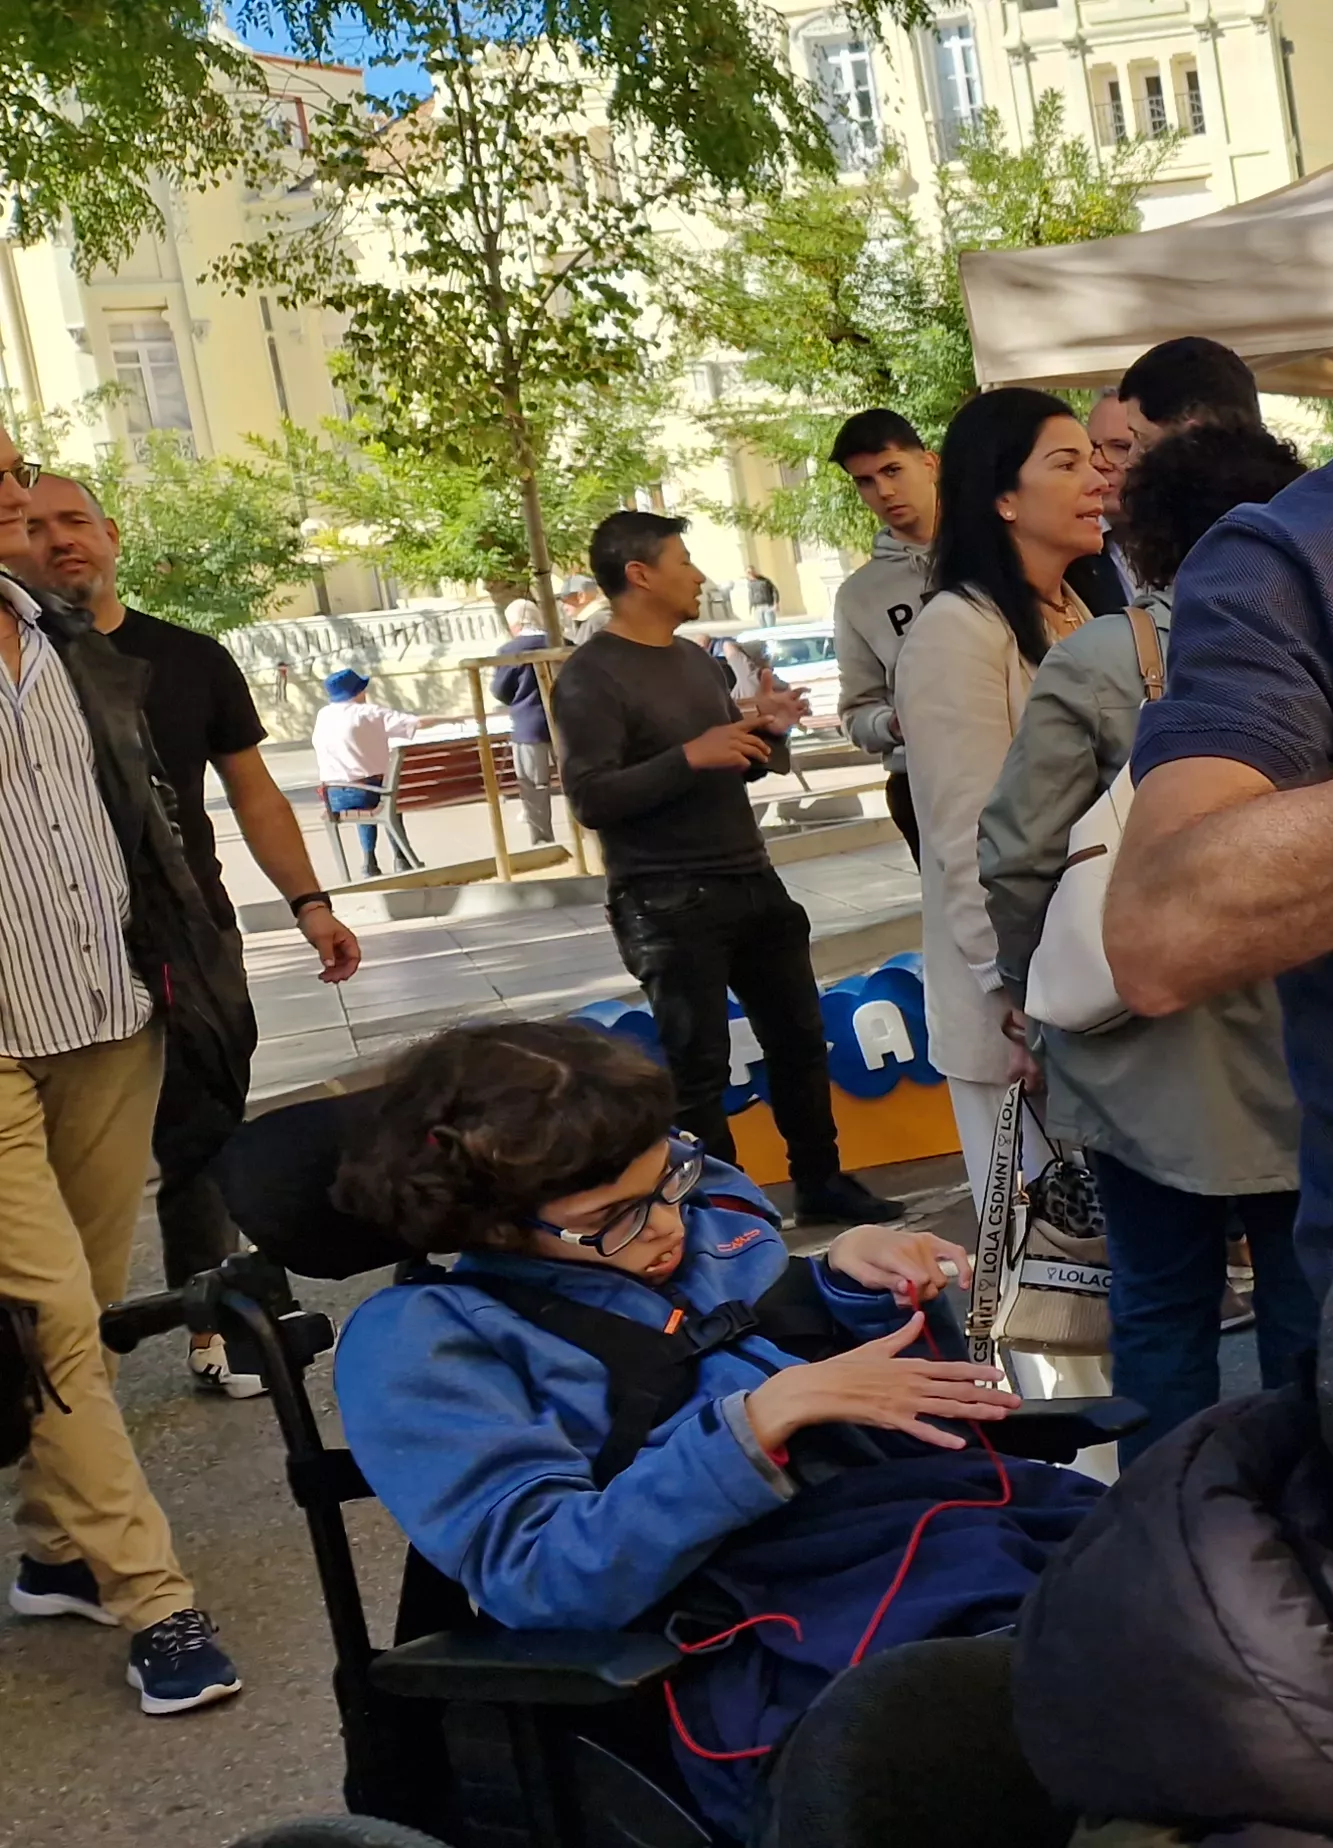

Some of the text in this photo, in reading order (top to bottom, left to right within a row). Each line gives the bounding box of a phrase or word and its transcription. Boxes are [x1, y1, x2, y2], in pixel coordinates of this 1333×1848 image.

[1001, 1086, 1018, 1132] LOLA
[989, 1154, 1010, 1227] CSDMNT
[982, 1231, 1000, 1274] LOLA
[1058, 1269, 1100, 1287] LOLA
